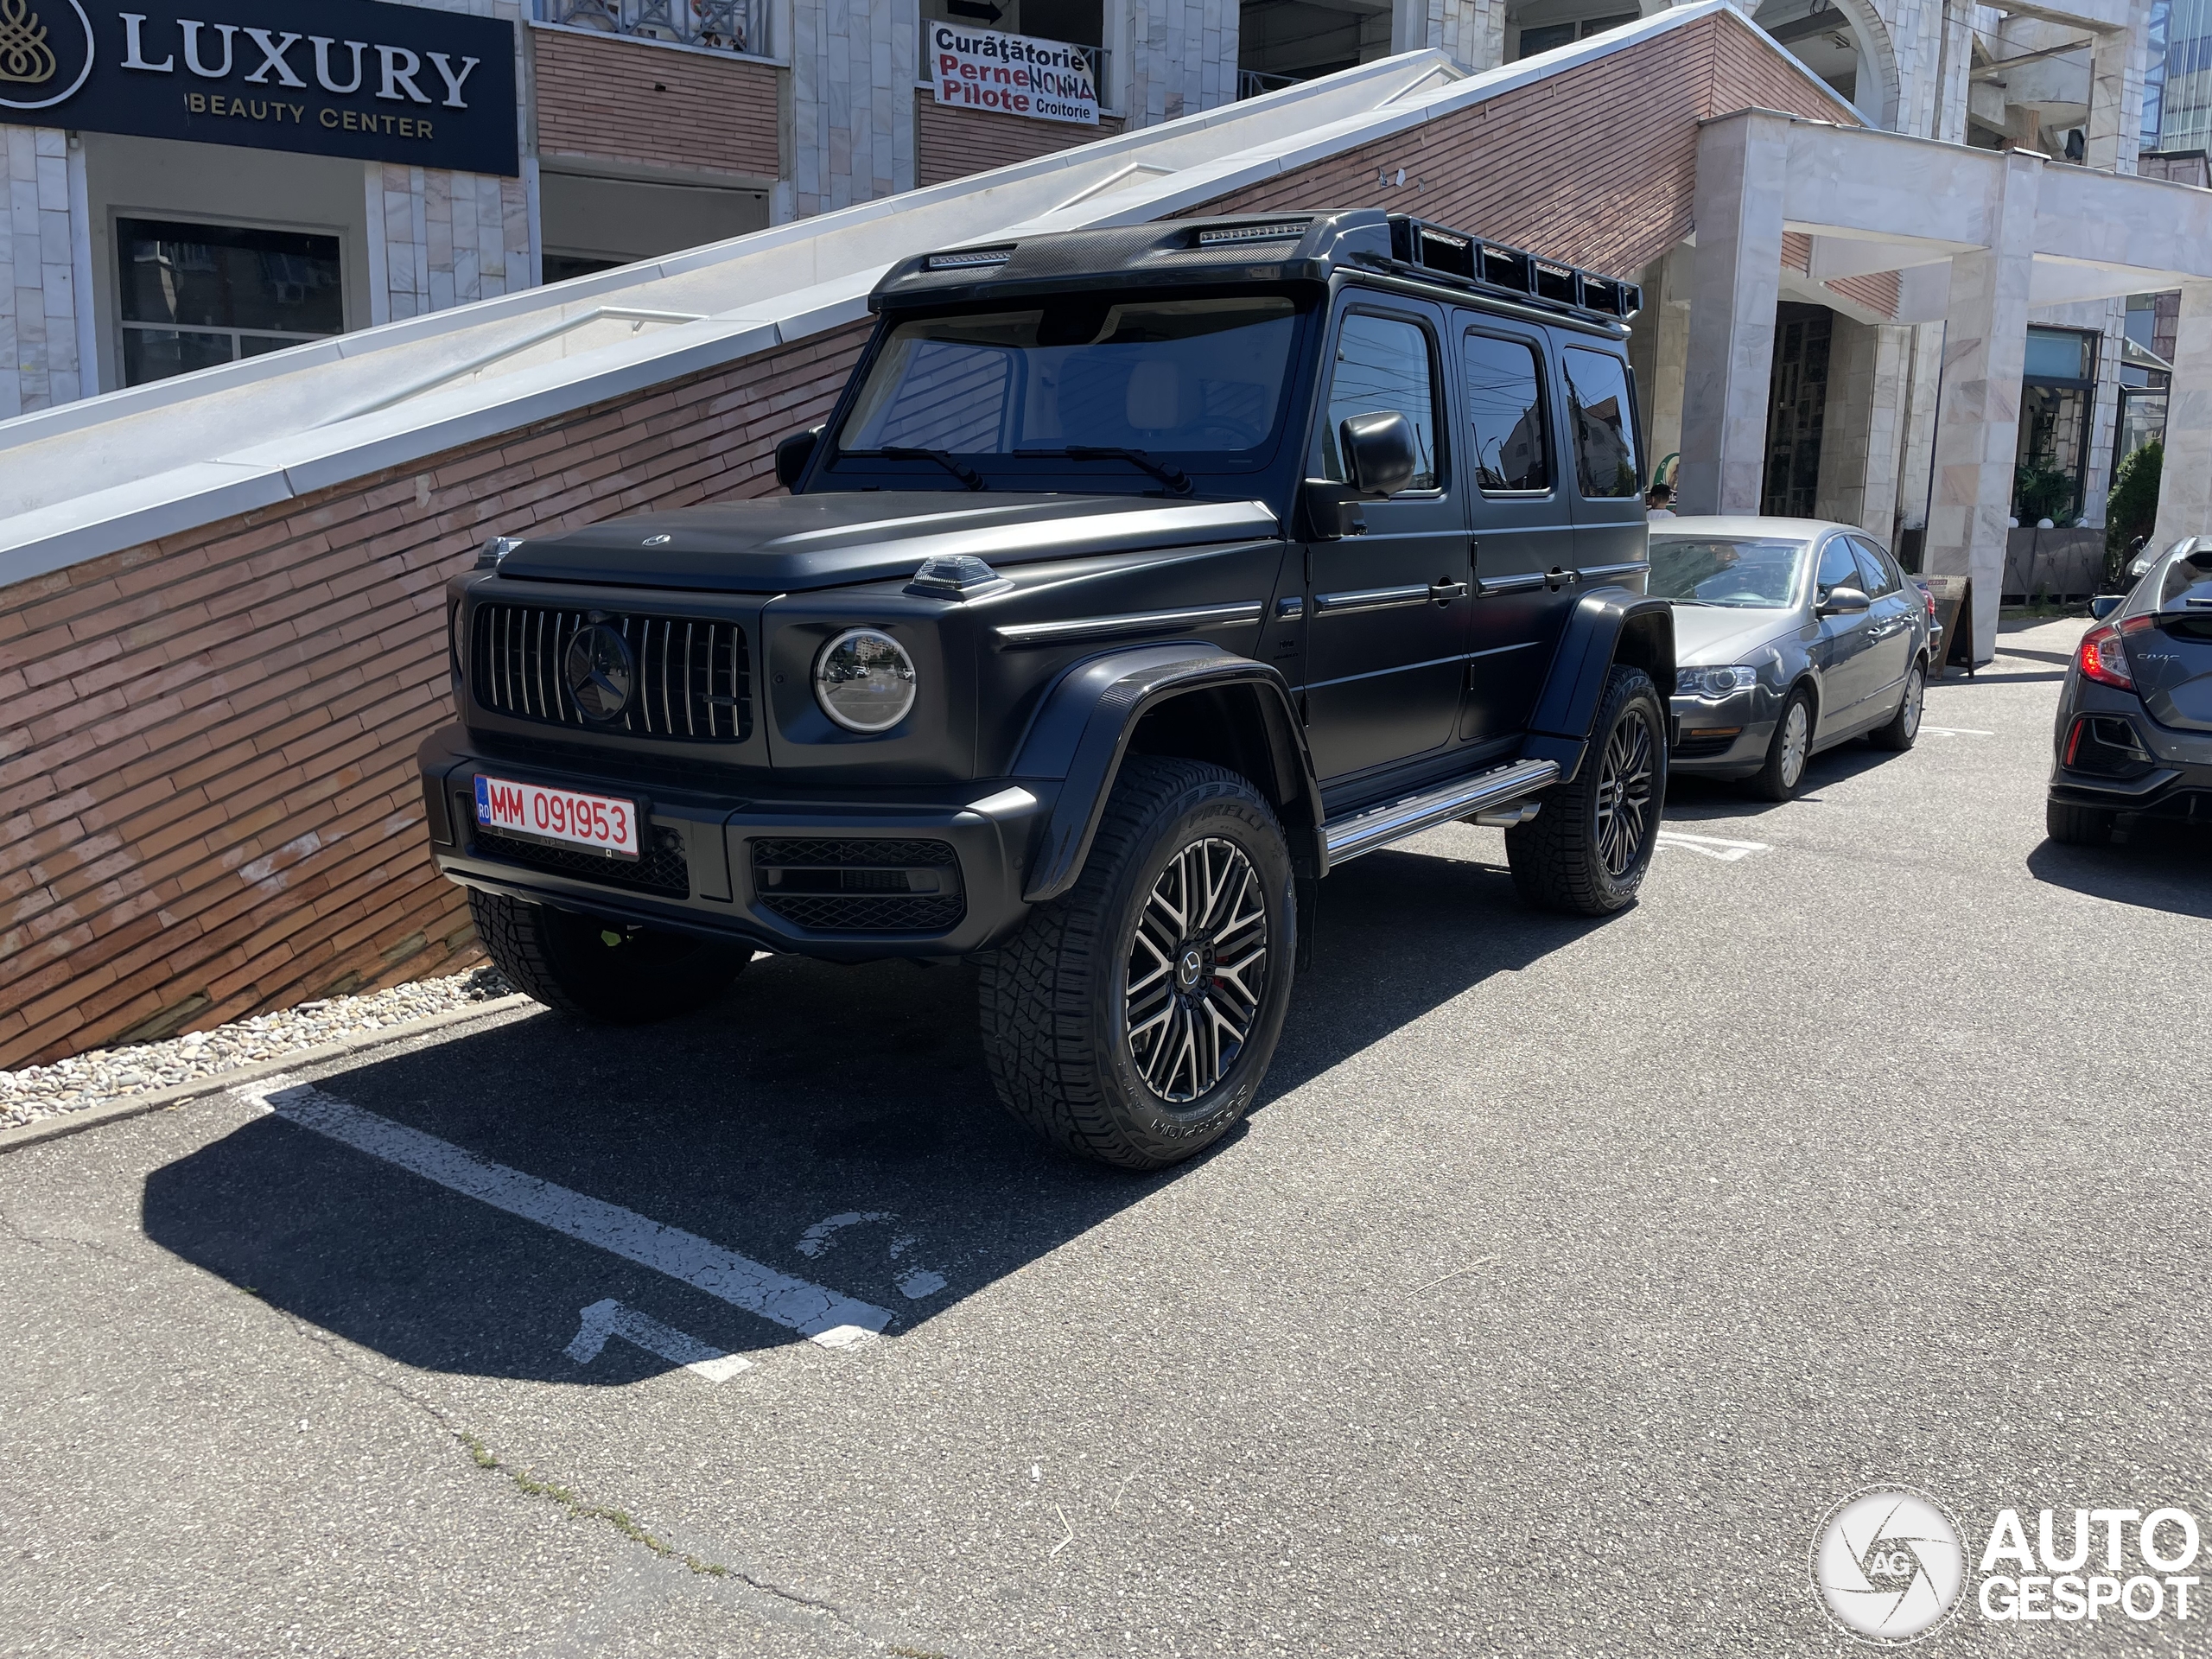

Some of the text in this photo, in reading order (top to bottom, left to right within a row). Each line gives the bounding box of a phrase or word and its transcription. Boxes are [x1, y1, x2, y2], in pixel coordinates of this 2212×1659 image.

[119, 12, 480, 109] LUXURY
[939, 54, 1029, 86] Perne
[189, 92, 433, 139] BEAUTY CENTER
[943, 79, 1090, 118] Pilote Croitorie
[479, 804, 490, 818] RO
[490, 785, 627, 844] MM 091953
